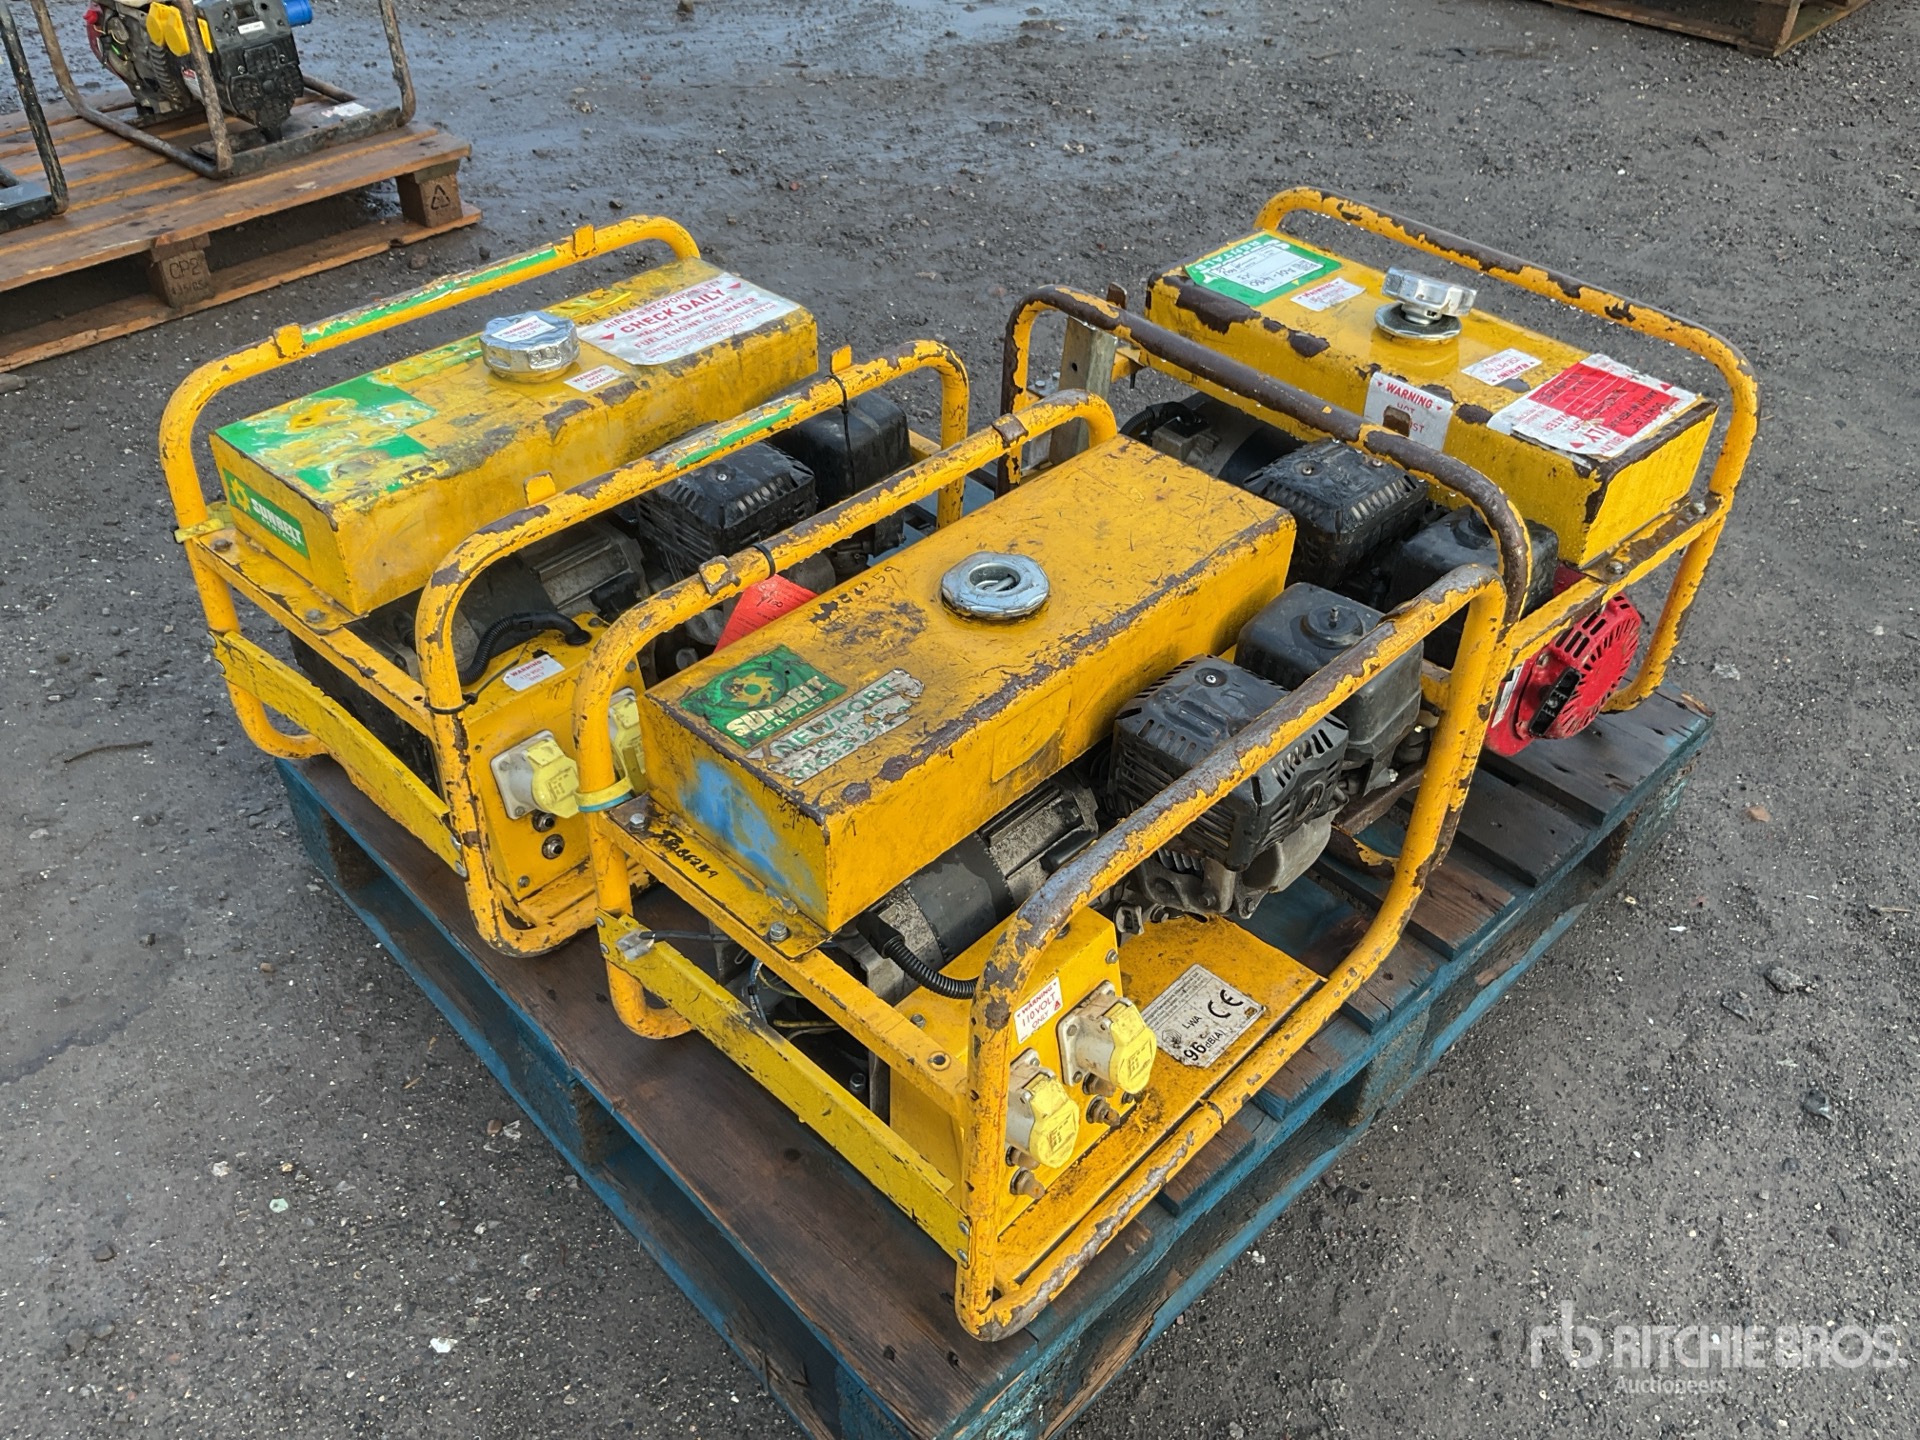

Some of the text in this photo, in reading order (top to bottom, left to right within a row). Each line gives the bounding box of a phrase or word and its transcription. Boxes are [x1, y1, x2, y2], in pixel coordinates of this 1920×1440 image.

[620, 307, 679, 334] CHECK
[678, 288, 726, 313] DAILY
[665, 319, 701, 338] ENGINE
[724, 297, 758, 313] WATER
[1496, 362, 1530, 380] WARNING
[1386, 382, 1433, 409] WARNING
[250, 497, 304, 546] SUNBELT
[510, 660, 542, 676] WARNING
[726, 675, 827, 737] SUNBELT
[774, 680, 896, 757] NEWPORT
[1021, 984, 1053, 1014] WARNING
[1022, 991, 1056, 1027] 110 VOLT
[1031, 1010, 1049, 1029] ONLY
[1182, 1015, 1203, 1029] LWA
[1183, 1029, 1226, 1061] 96 dB(A)
